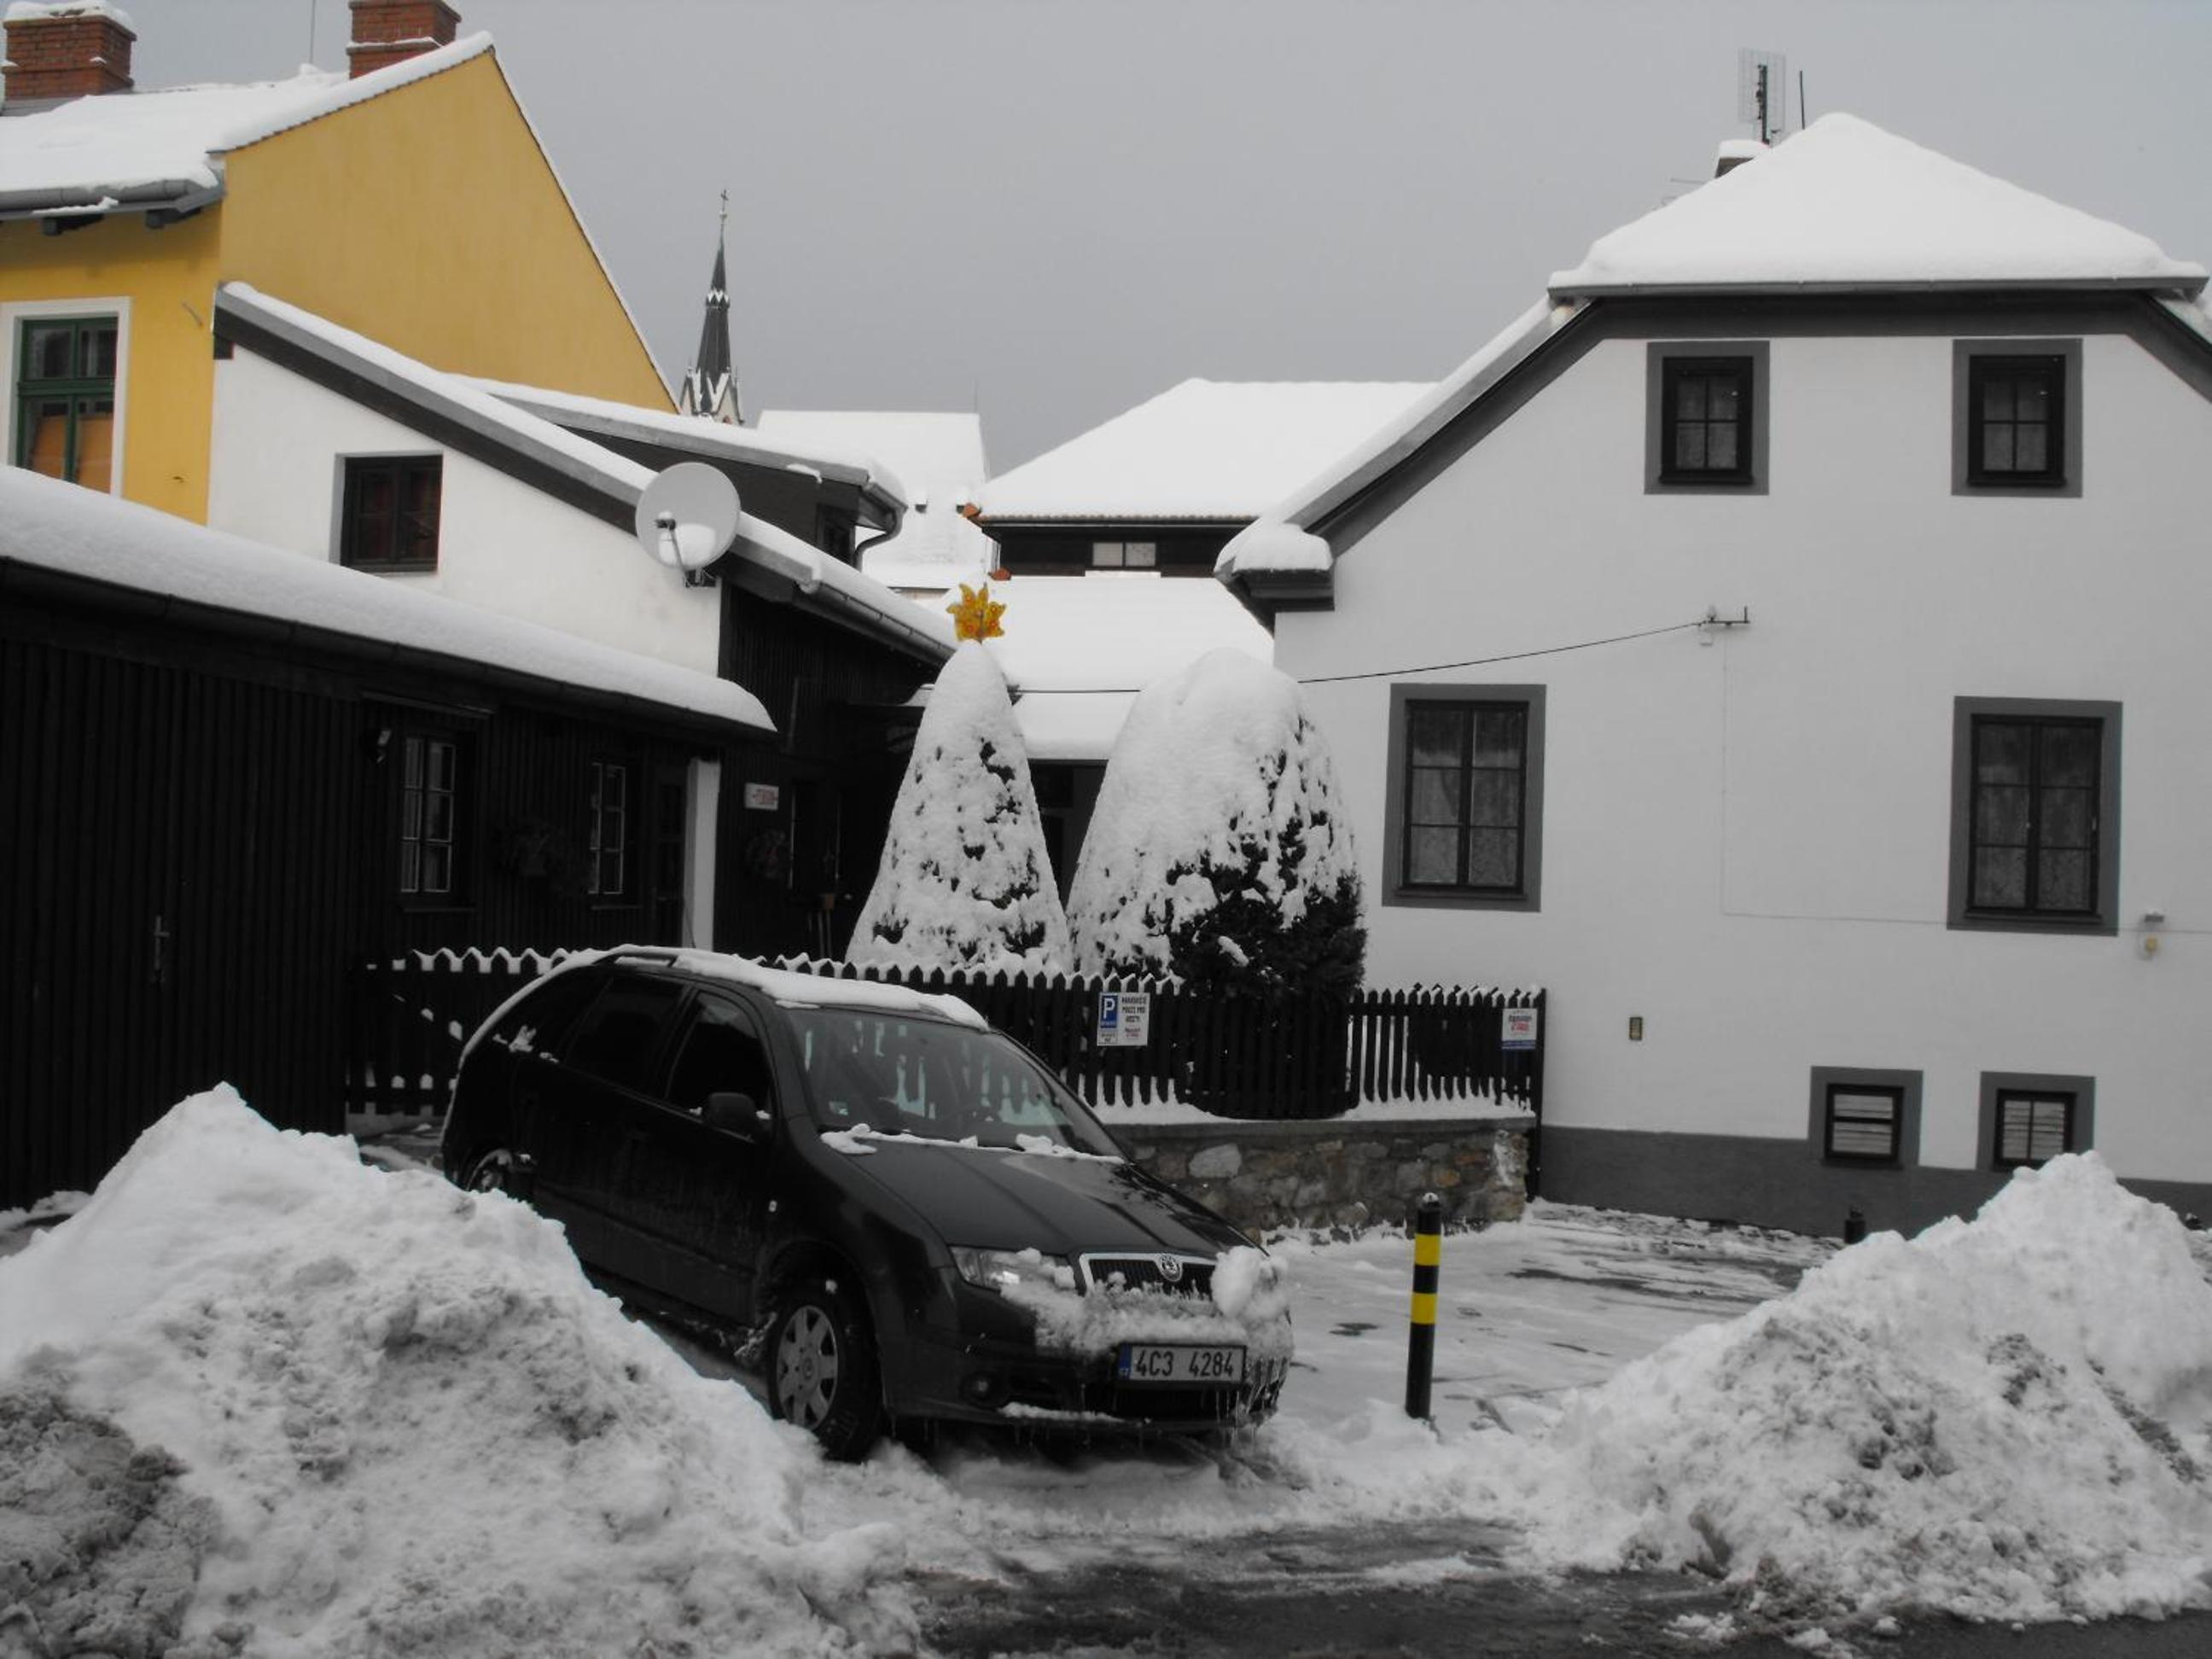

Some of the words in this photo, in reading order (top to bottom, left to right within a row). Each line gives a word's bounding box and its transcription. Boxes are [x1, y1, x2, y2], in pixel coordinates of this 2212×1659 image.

[1103, 998, 1115, 1019] P
[1135, 1349, 1174, 1377] 4C3
[1189, 1351, 1233, 1377] 4284
